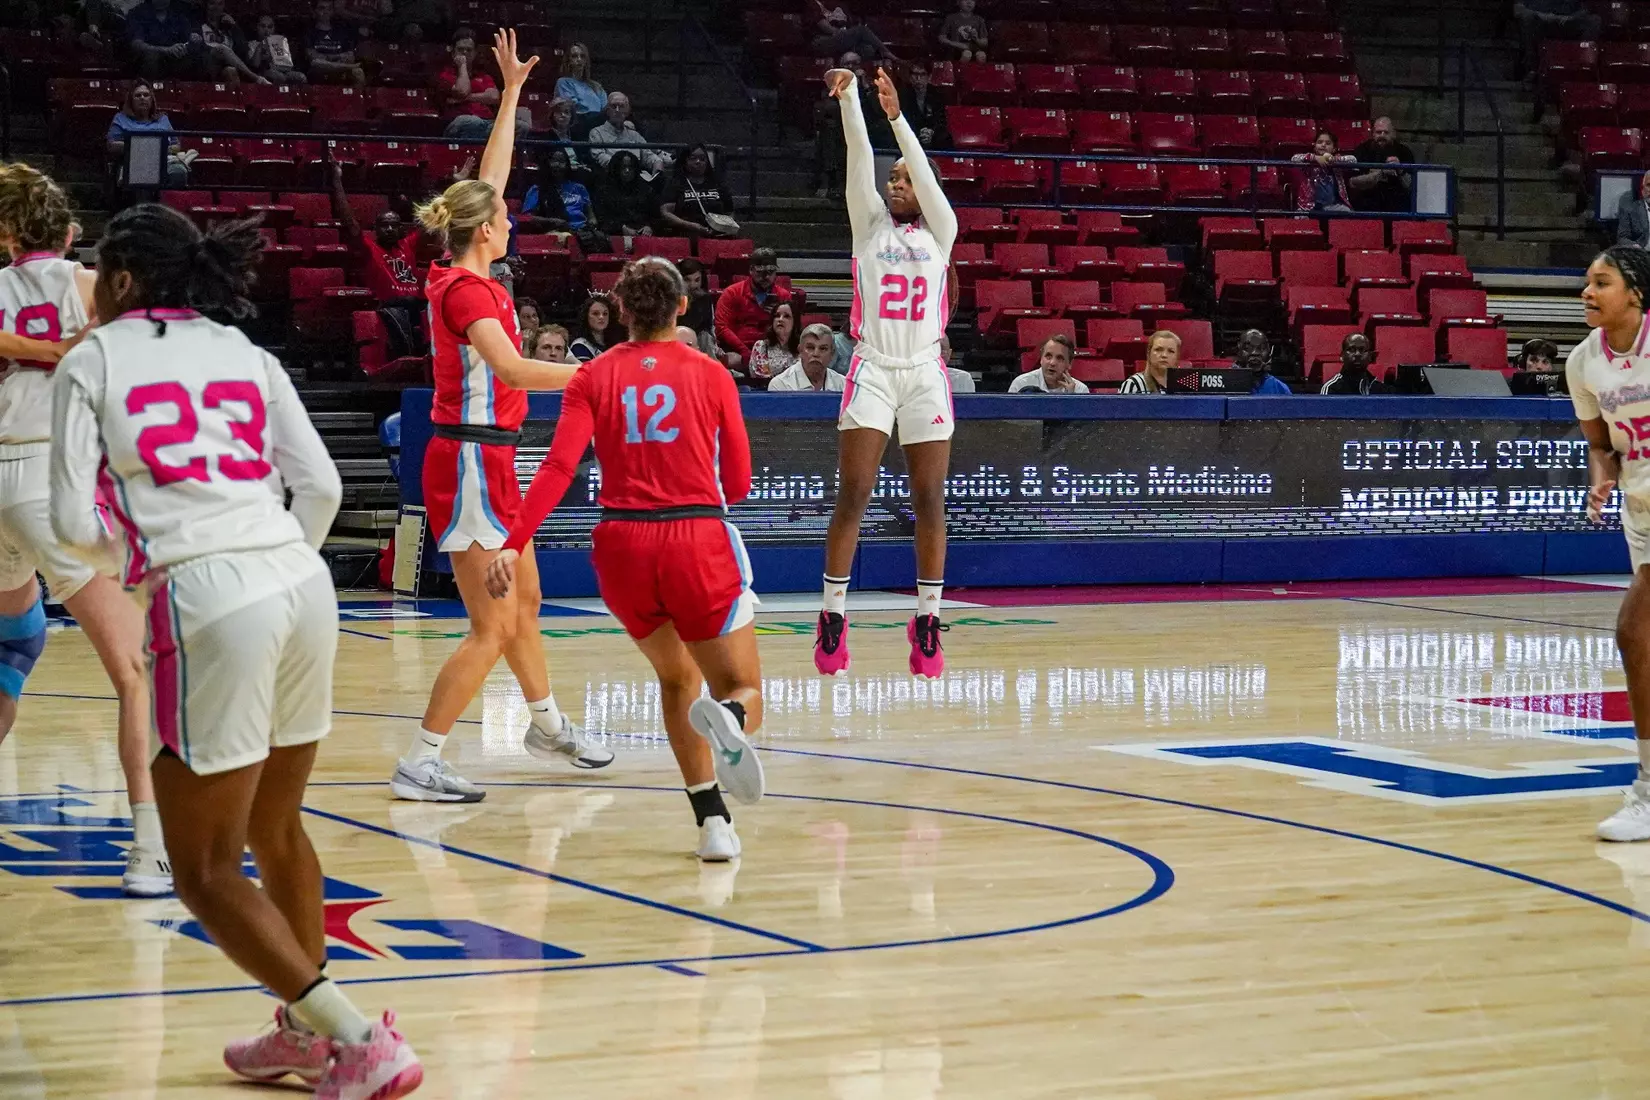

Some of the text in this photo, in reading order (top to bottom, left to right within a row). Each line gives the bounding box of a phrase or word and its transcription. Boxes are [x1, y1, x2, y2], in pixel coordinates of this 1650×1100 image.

[879, 273, 928, 322] 22
[1201, 375, 1225, 388] POSS.
[621, 384, 680, 444] 12
[125, 380, 272, 487] 23
[1343, 440, 1588, 470] OFFICIAL SPORT
[746, 466, 824, 499] siana
[1020, 466, 1042, 496] &
[1051, 465, 1140, 503] Sports
[1148, 465, 1272, 496] Medicine
[1341, 486, 1498, 515] MEDICINE
